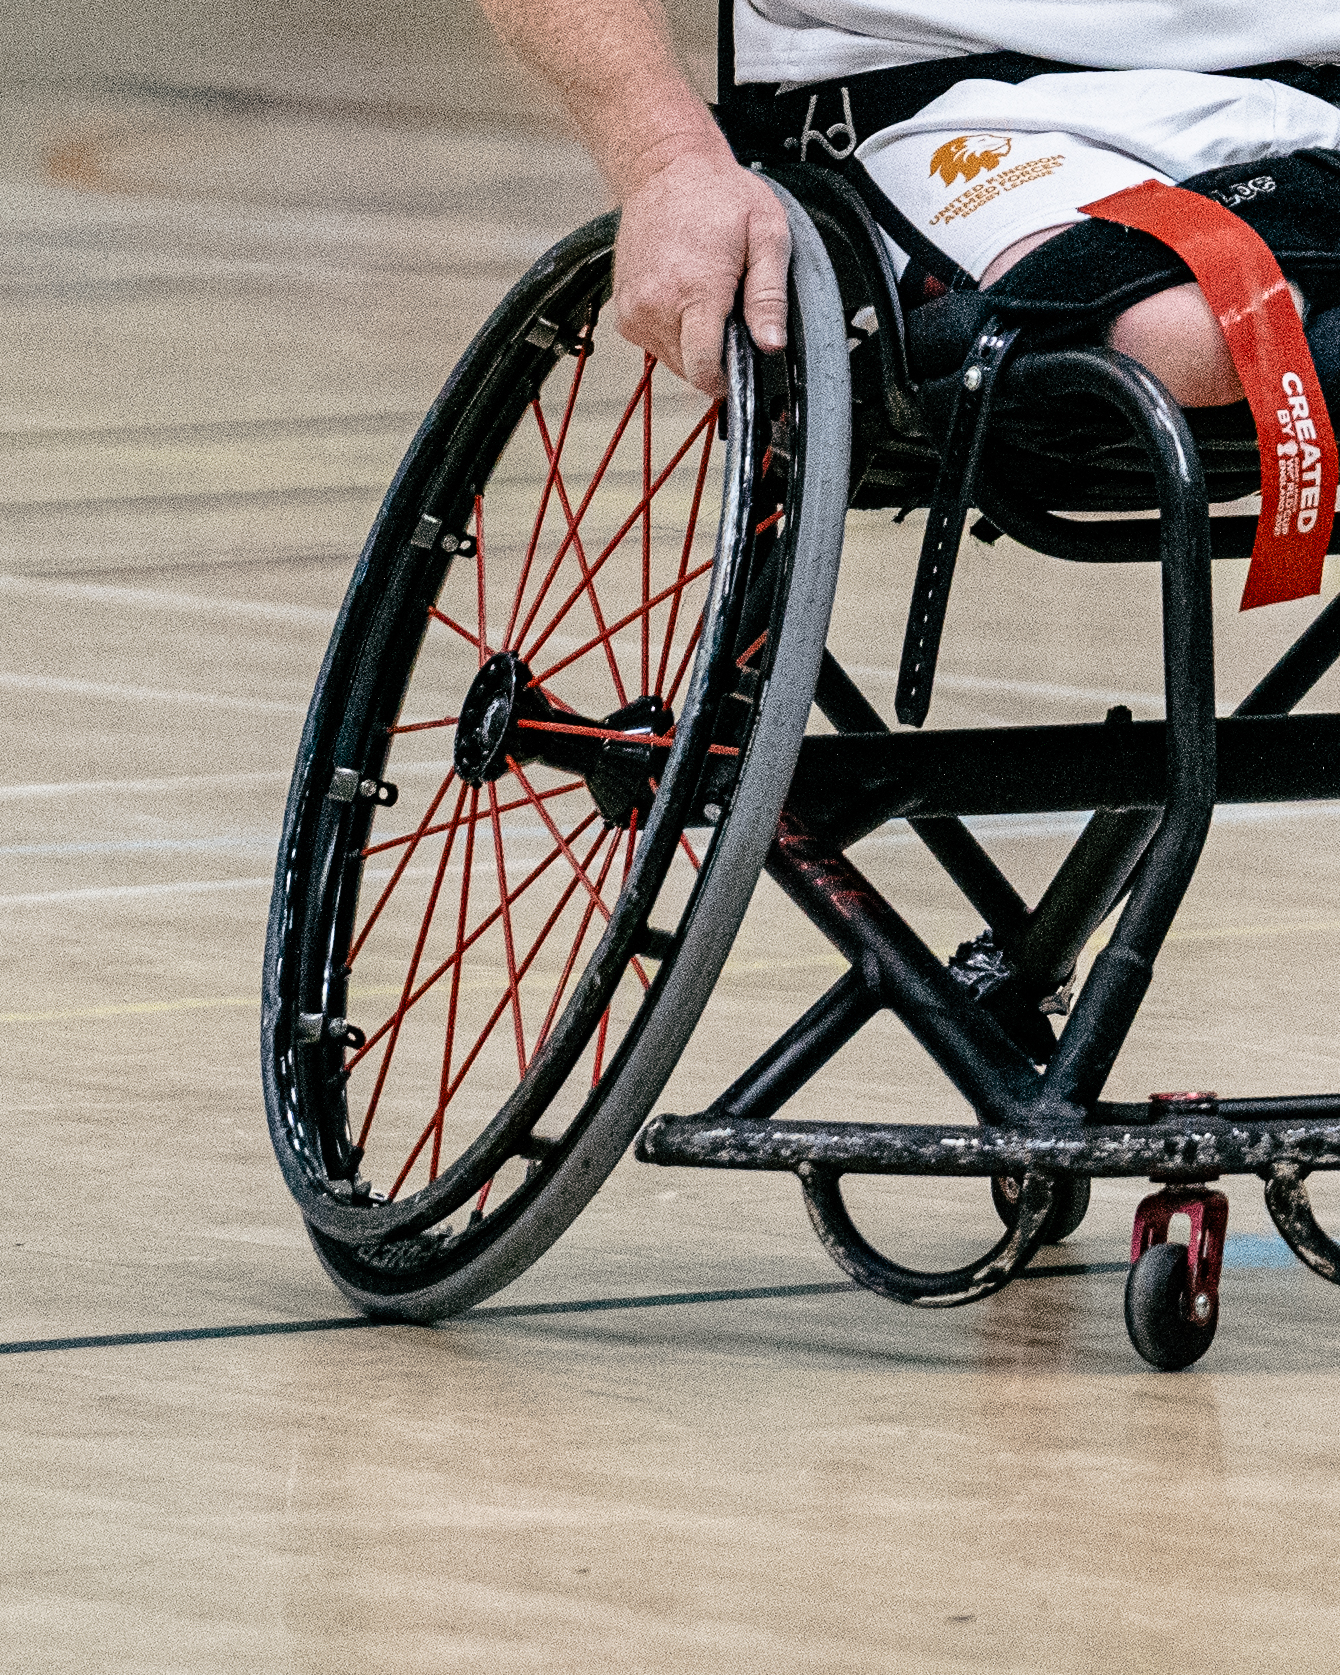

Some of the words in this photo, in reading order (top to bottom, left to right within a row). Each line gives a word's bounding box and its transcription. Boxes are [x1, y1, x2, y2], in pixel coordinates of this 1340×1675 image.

[929, 184, 984, 226] UNITED
[985, 154, 1066, 185] KINGDOM
[945, 186, 997, 225] ARMED
[999, 161, 1063, 186] FORCES
[961, 189, 1000, 218] RUGBY
[1003, 170, 1054, 192] LEAGUE
[1277, 409, 1296, 437] BY
[1282, 371, 1322, 533] CREATED
